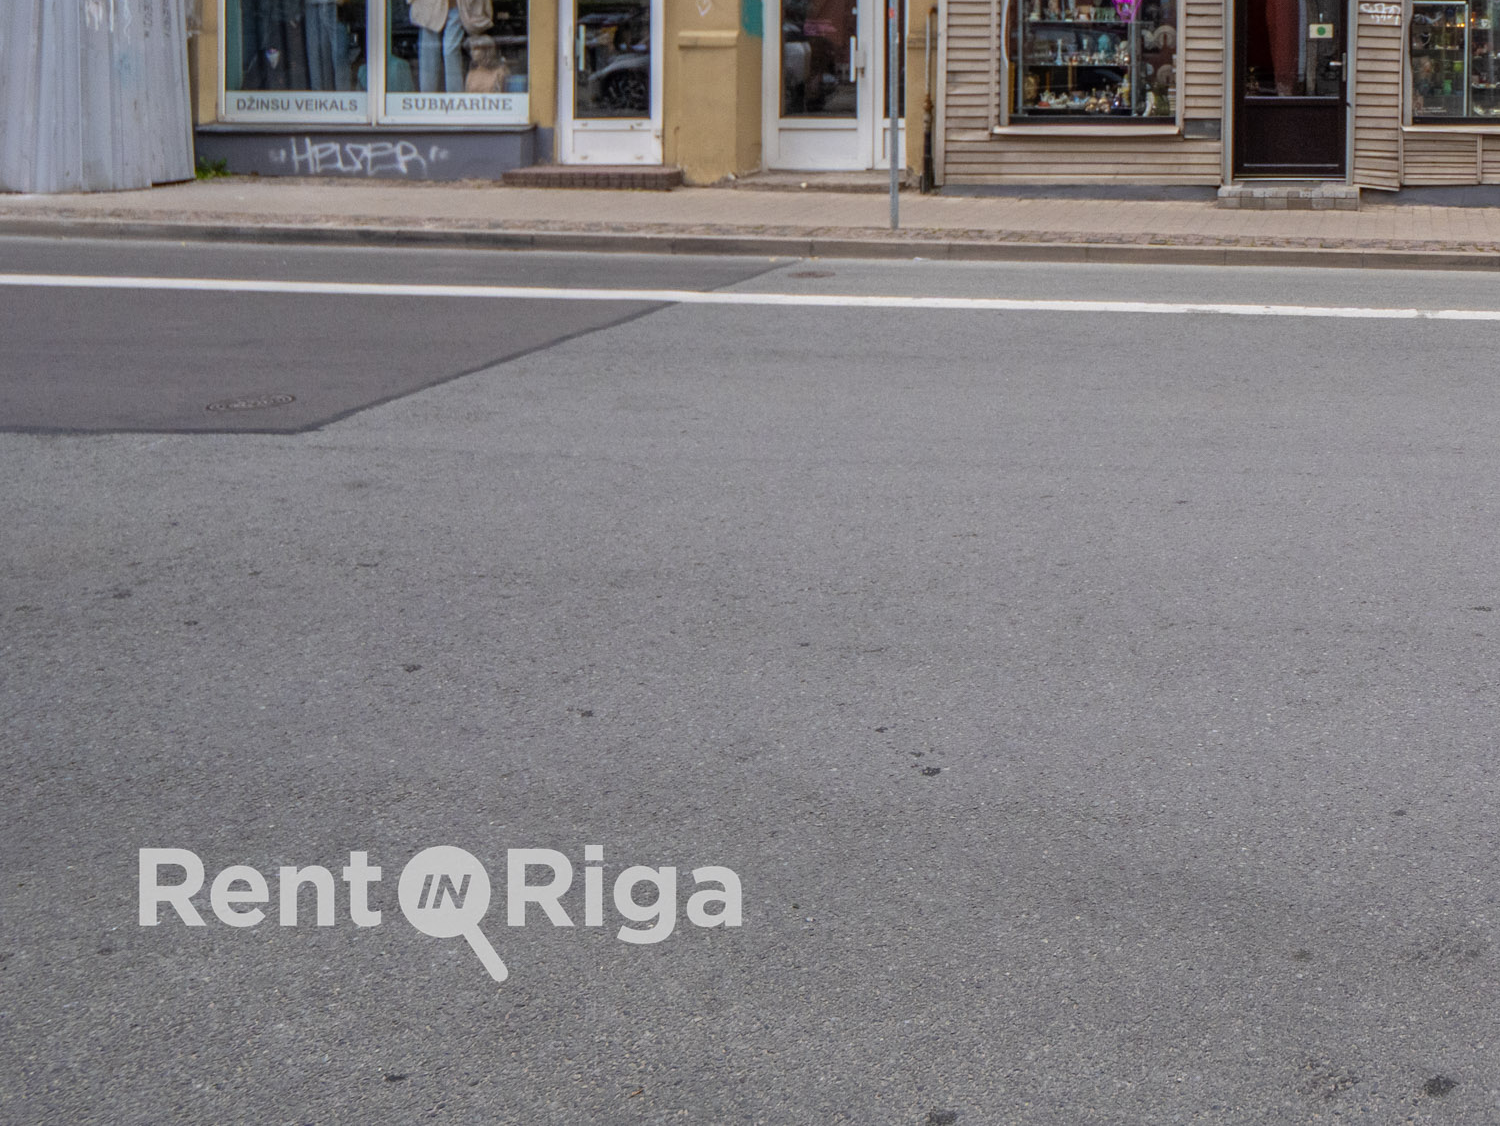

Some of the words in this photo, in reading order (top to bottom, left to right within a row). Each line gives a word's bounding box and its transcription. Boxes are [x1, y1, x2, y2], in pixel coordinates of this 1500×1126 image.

[236, 96, 291, 112] DŽINSU
[295, 98, 358, 113] VEIKALS
[402, 96, 513, 114] SUBMARĪNE
